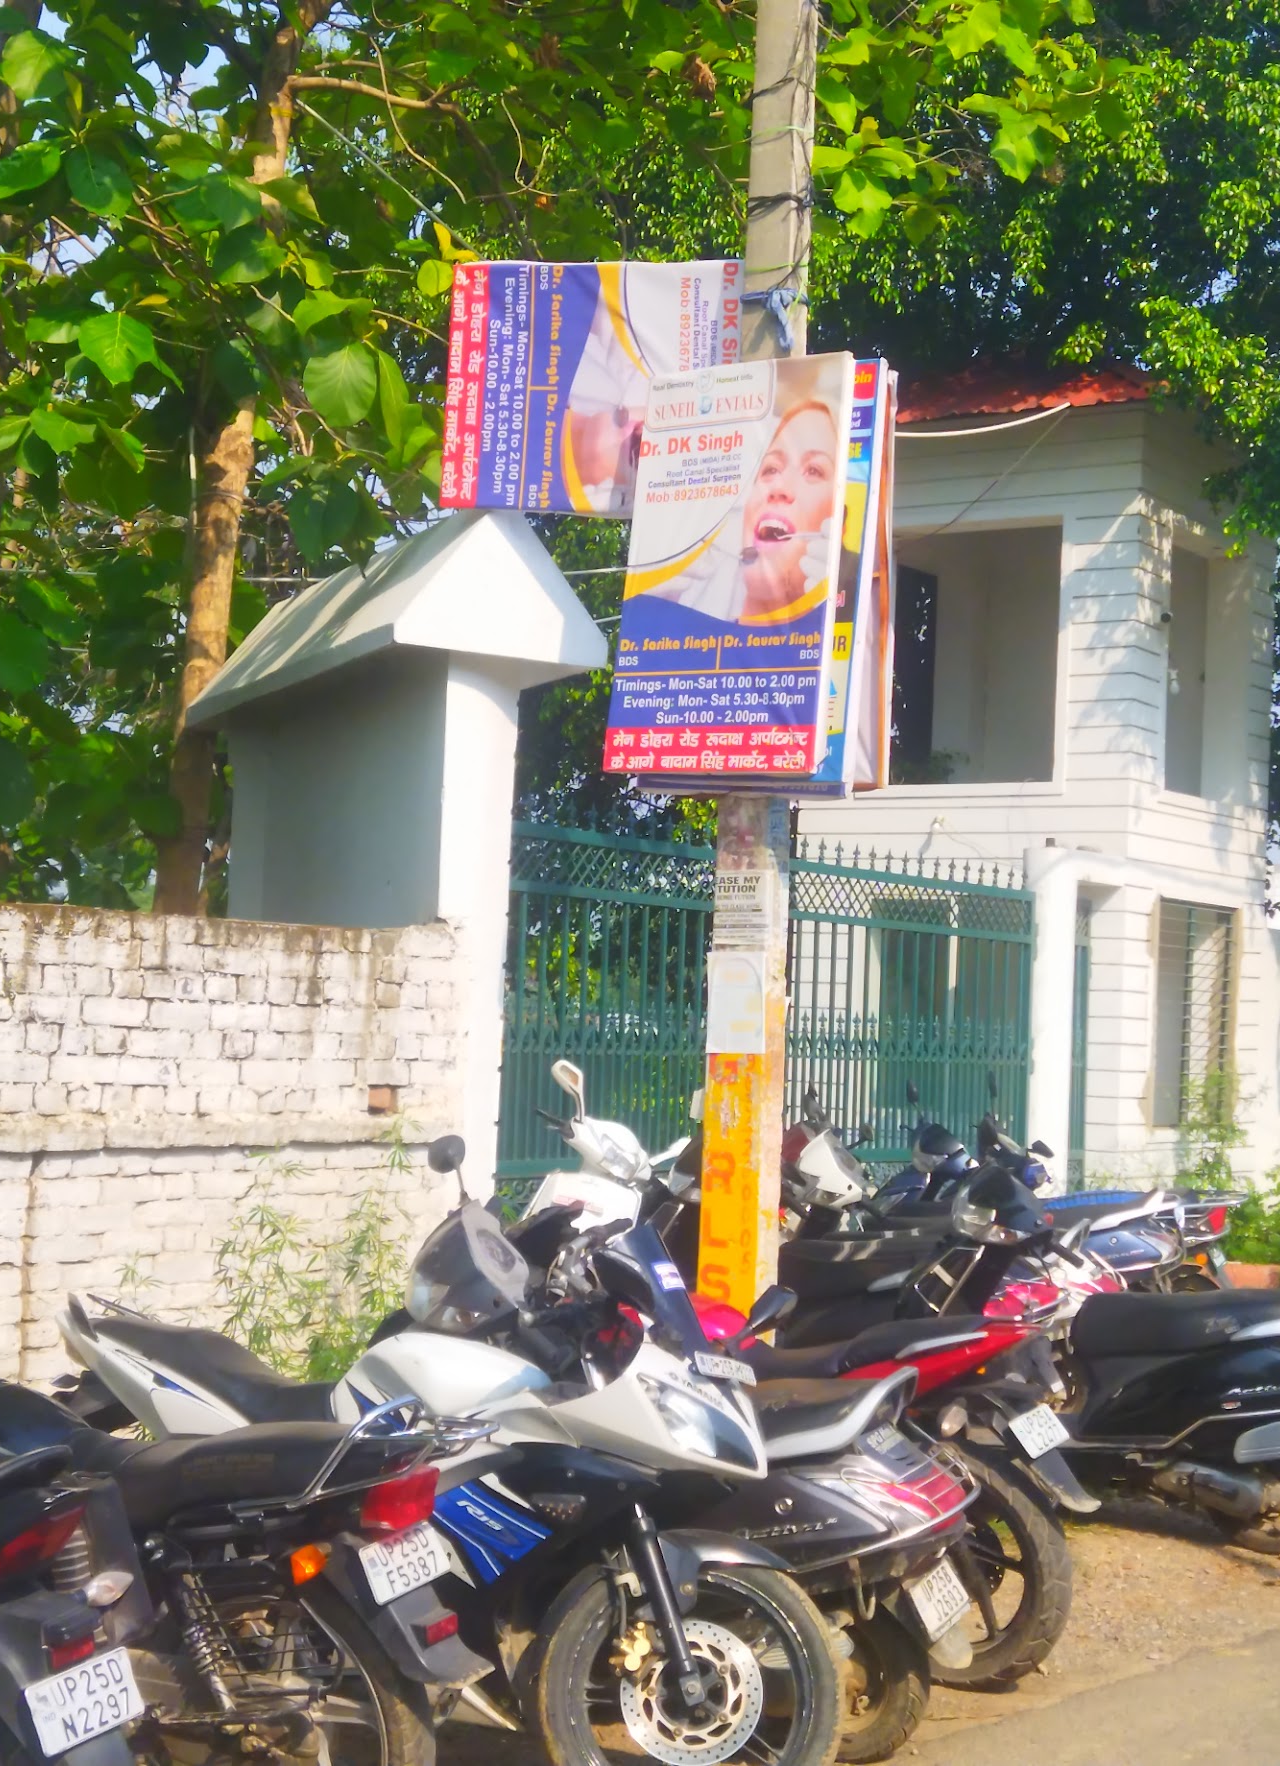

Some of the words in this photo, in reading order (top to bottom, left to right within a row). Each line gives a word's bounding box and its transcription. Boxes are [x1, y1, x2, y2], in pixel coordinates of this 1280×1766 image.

[473, 269, 487, 296] मेन
[540, 265, 549, 290] BDS
[552, 265, 564, 289] Dr.
[724, 263, 738, 290] Dr.
[502, 278, 515, 339] Evening:
[516, 265, 530, 328] Timings-
[551, 294, 563, 340] Sarika
[723, 299, 738, 329] DK
[468, 350, 484, 374] रोड
[546, 345, 561, 384] Singh
[499, 383, 510, 406] Sat
[546, 394, 558, 416] Dr.
[512, 394, 524, 430] 10.00
[481, 402, 496, 451] 2.00pm
[511, 434, 521, 448] to
[544, 421, 556, 467] Saurav
[640, 441, 661, 457] Dr.
[667, 436, 691, 455] DK
[697, 430, 743, 454] Singh
[509, 451, 520, 480] 2.00
[666, 470, 683, 478] Root
[685, 468, 705, 476] Canal
[706, 464, 740, 475] Specialist
[681, 458, 698, 467] BDS
[538, 470, 553, 508] Singh
[648, 479, 686, 488] Consultant
[688, 476, 710, 485] Dental
[713, 473, 741, 483] Surgeon
[505, 484, 516, 506] pm
[528, 485, 537, 507] BDS
[620, 639, 638, 652] Dr.
[643, 637, 681, 651] Sarika
[684, 634, 716, 651] Singh
[724, 634, 742, 648] Dr.
[747, 633, 786, 646] Saurav
[789, 631, 820, 649] Singh
[618, 656, 638, 666] BDS
[800, 649, 819, 660] BDS
[616, 678, 666, 693] Timings-
[669, 677, 717, 690] Mon-Sat
[721, 676, 752, 689] 10.00
[754, 676, 767, 688] to
[770, 675, 794, 688] 2.00
[798, 676, 817, 690] pm
[623, 696, 675, 709] Evening:
[678, 695, 707, 707] Mon-
[711, 693, 730, 706] Sat
[733, 692, 804, 707] 5.30-8.30pm
[656, 711, 714, 724] Sun-10.00
[725, 710, 769, 725] 2.00pm
[613, 729, 634, 747] मेन
[640, 729, 673, 747] डोहरा
[680, 729, 700, 747] रोड
[611, 752, 623, 769] के
[626, 751, 655, 769] आगे
[661, 755, 697, 769] बादाम
[700, 750, 725, 770] सिंह
[773, 750, 806, 769] बरेली
[743, 876, 761, 884] MY
[373, 1528, 429, 1567] UP25D
[386, 1551, 438, 1594] F5387
[50, 1658, 124, 1707] UP25D
[61, 1686, 130, 1742] N2297
